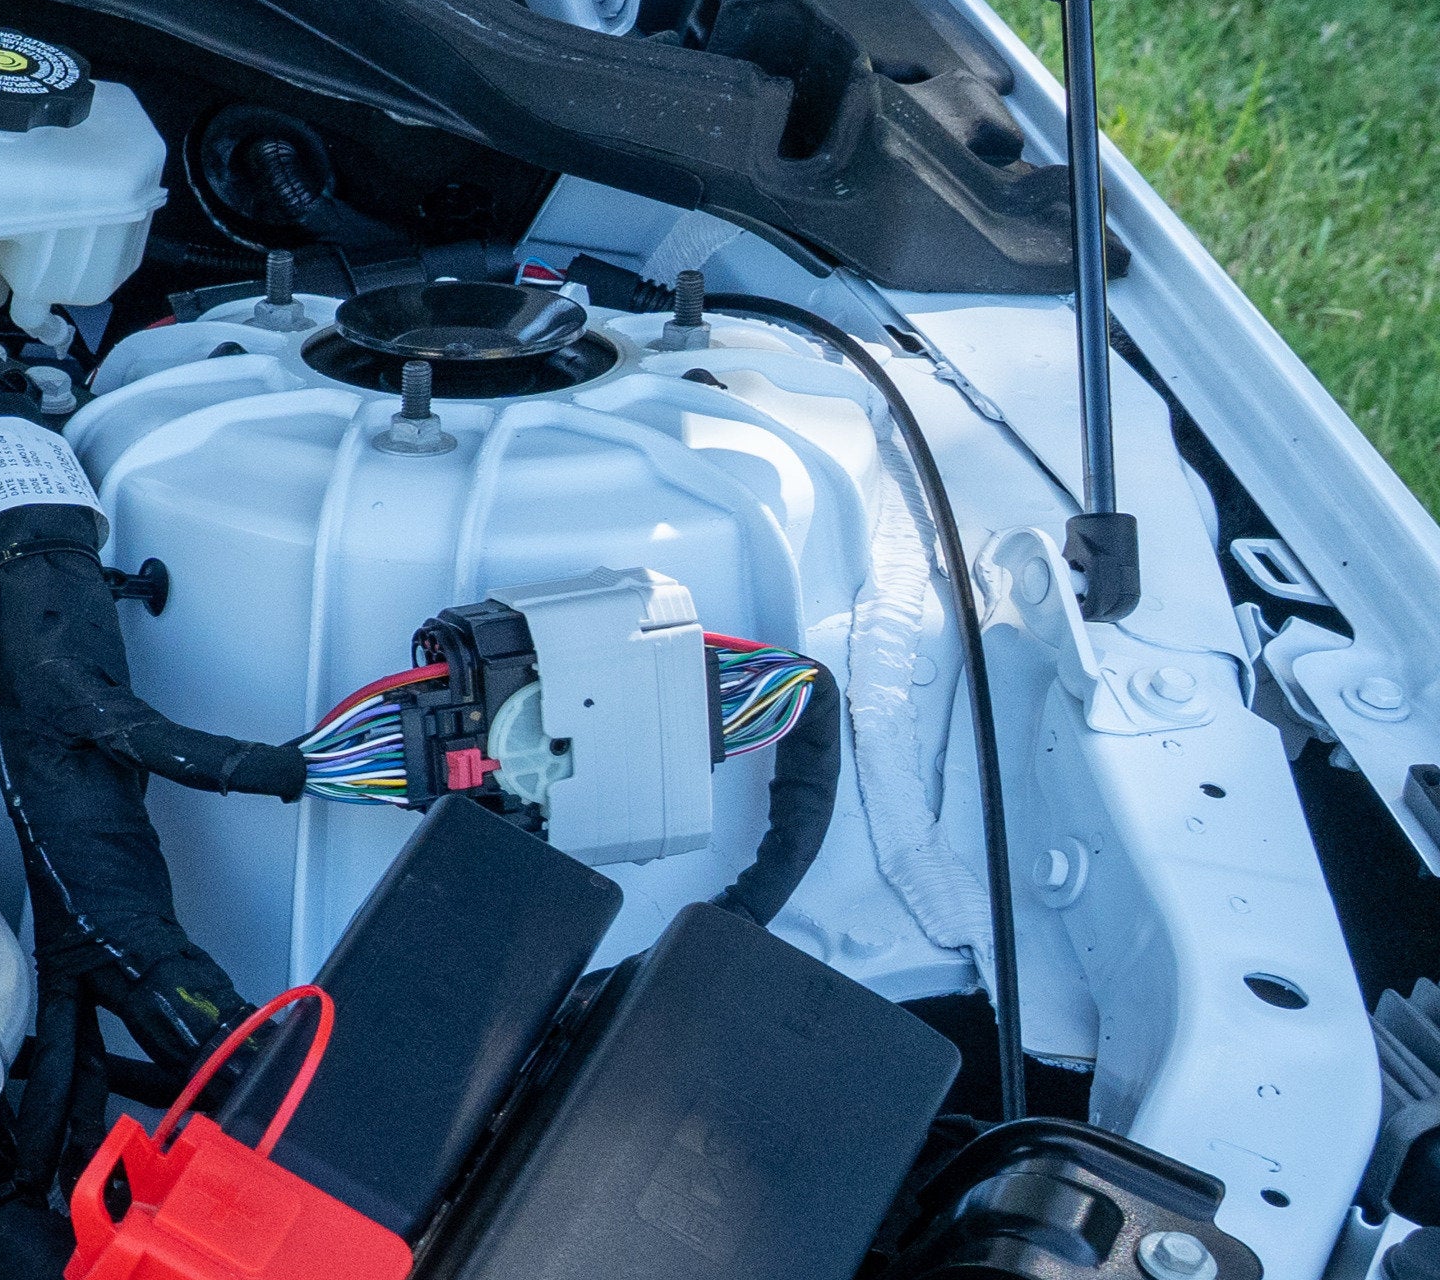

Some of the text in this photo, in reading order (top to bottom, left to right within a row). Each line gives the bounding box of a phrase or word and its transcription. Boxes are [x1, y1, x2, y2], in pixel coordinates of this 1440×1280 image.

[5, 478, 19, 496] DATE
[17, 478, 31, 495] TIME
[29, 477, 43, 494] CODE
[40, 473, 54, 495] PLANT
